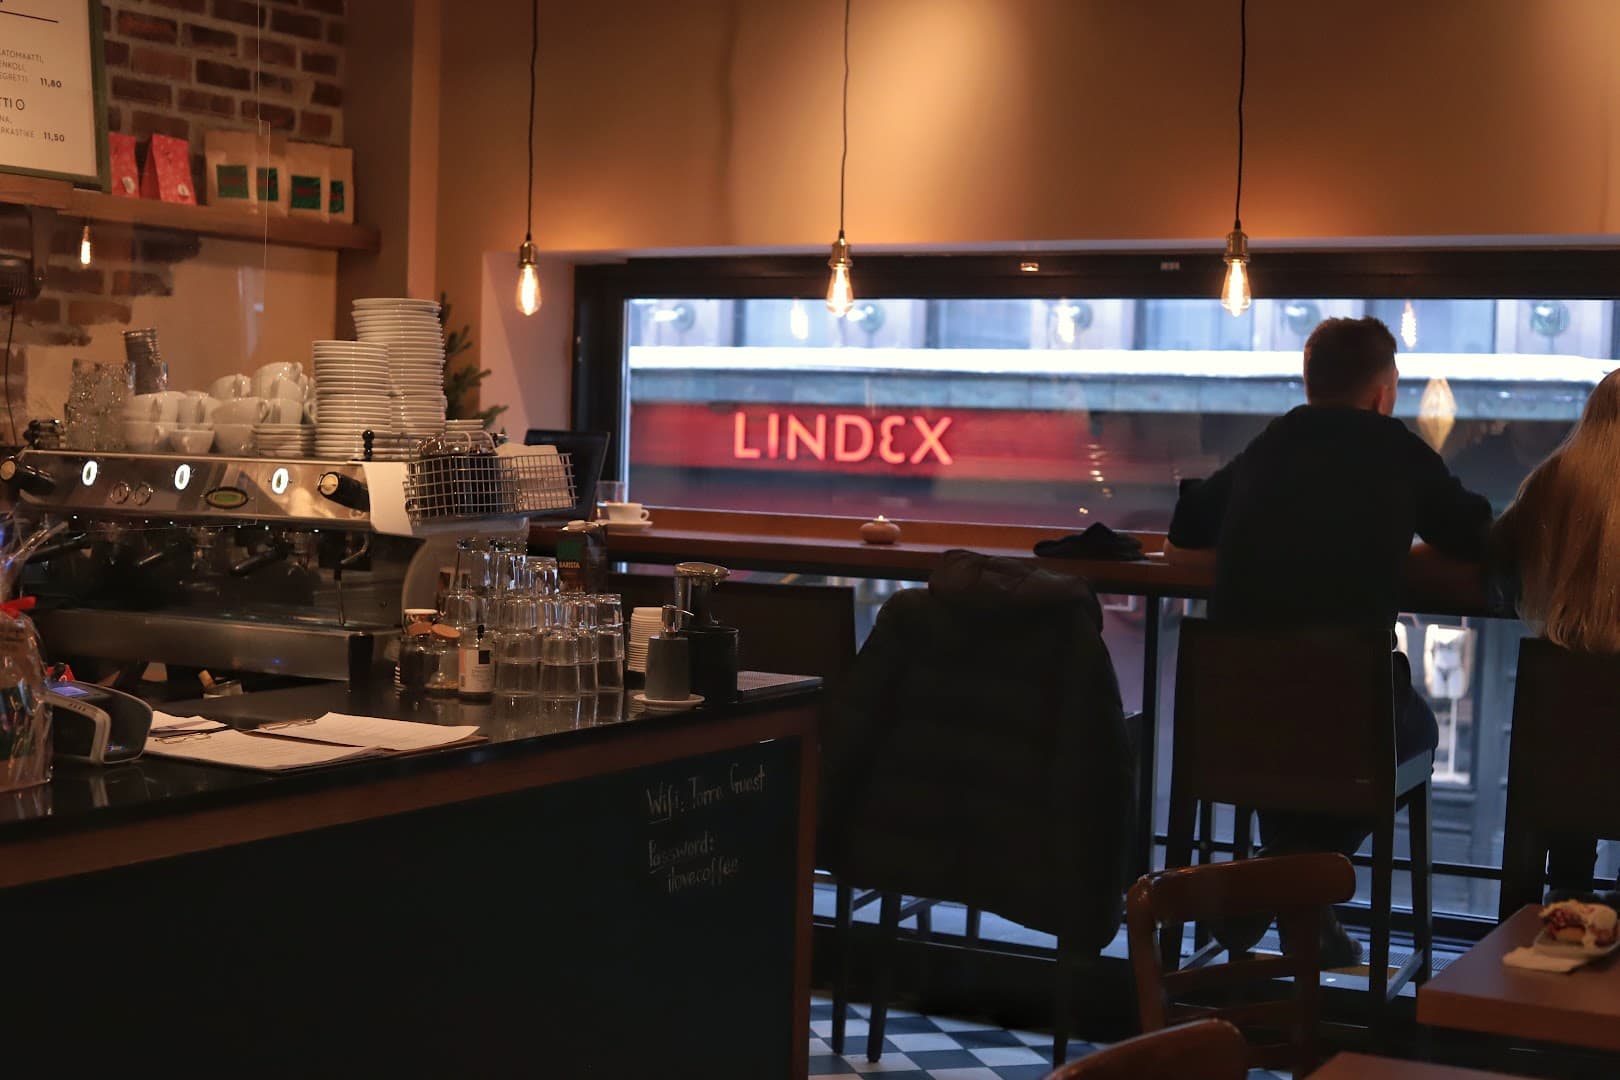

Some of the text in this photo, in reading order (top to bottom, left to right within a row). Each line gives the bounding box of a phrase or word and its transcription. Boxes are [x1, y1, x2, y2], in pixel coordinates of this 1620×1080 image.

[40, 77, 62, 89] 11,80
[43, 131, 65, 143] 11,50
[734, 411, 953, 465] LINDEX
[558, 561, 581, 569] BARISTA
[730, 763, 766, 794] Guest
[648, 831, 715, 868] Password:
